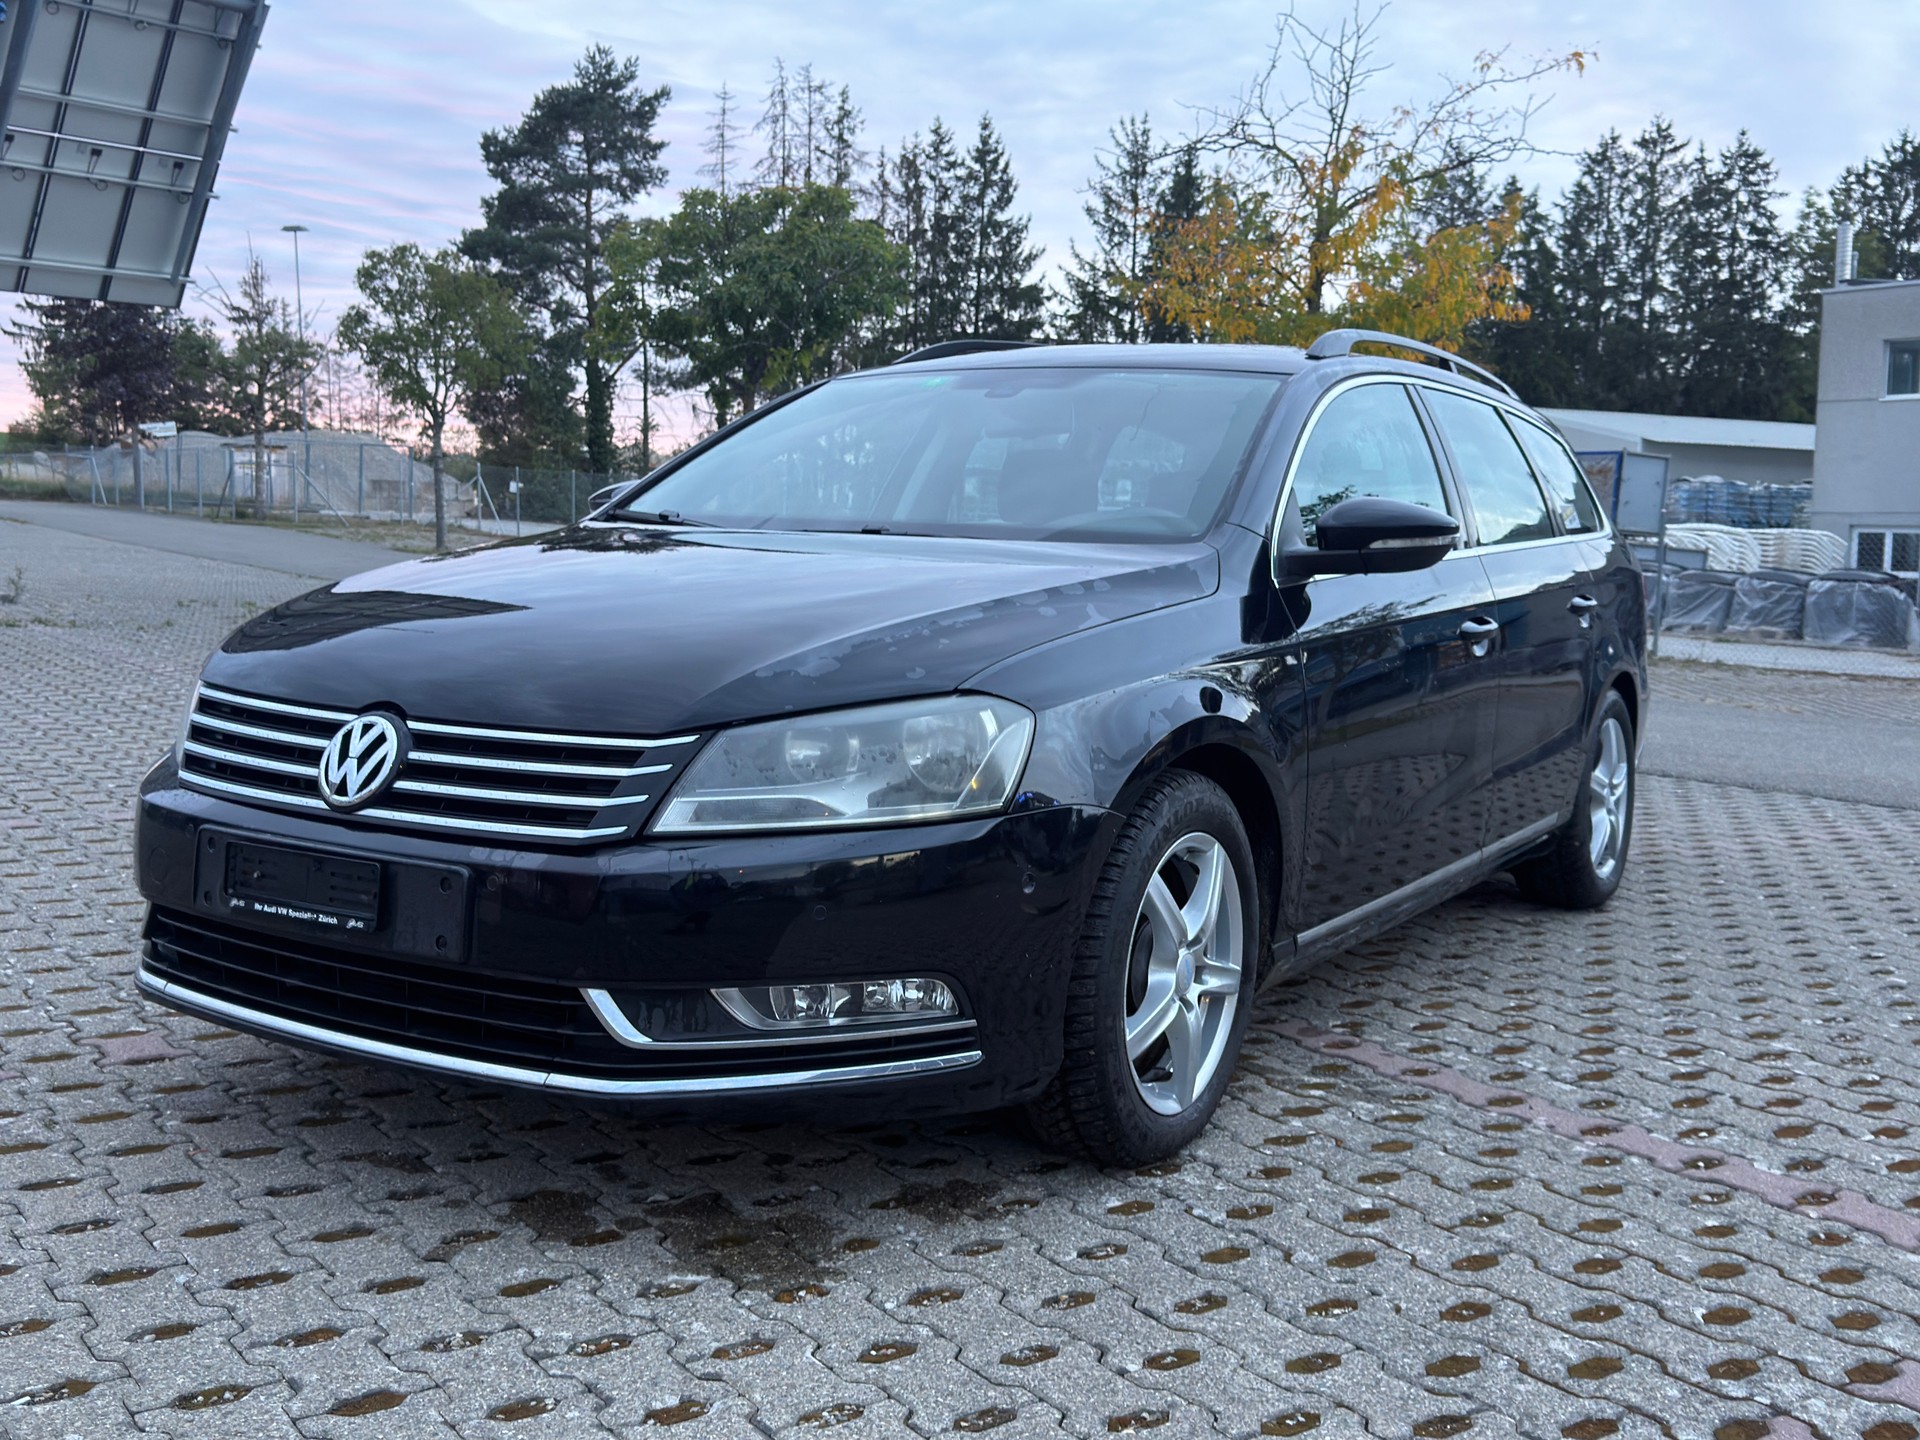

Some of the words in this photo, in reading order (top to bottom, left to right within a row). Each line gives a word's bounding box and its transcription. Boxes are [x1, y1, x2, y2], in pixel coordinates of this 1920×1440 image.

[321, 716, 397, 804] VW
[254, 902, 263, 911] Ihr
[263, 904, 277, 914] Audi
[278, 906, 288, 916] VW
[318, 914, 339, 925] Zürich
